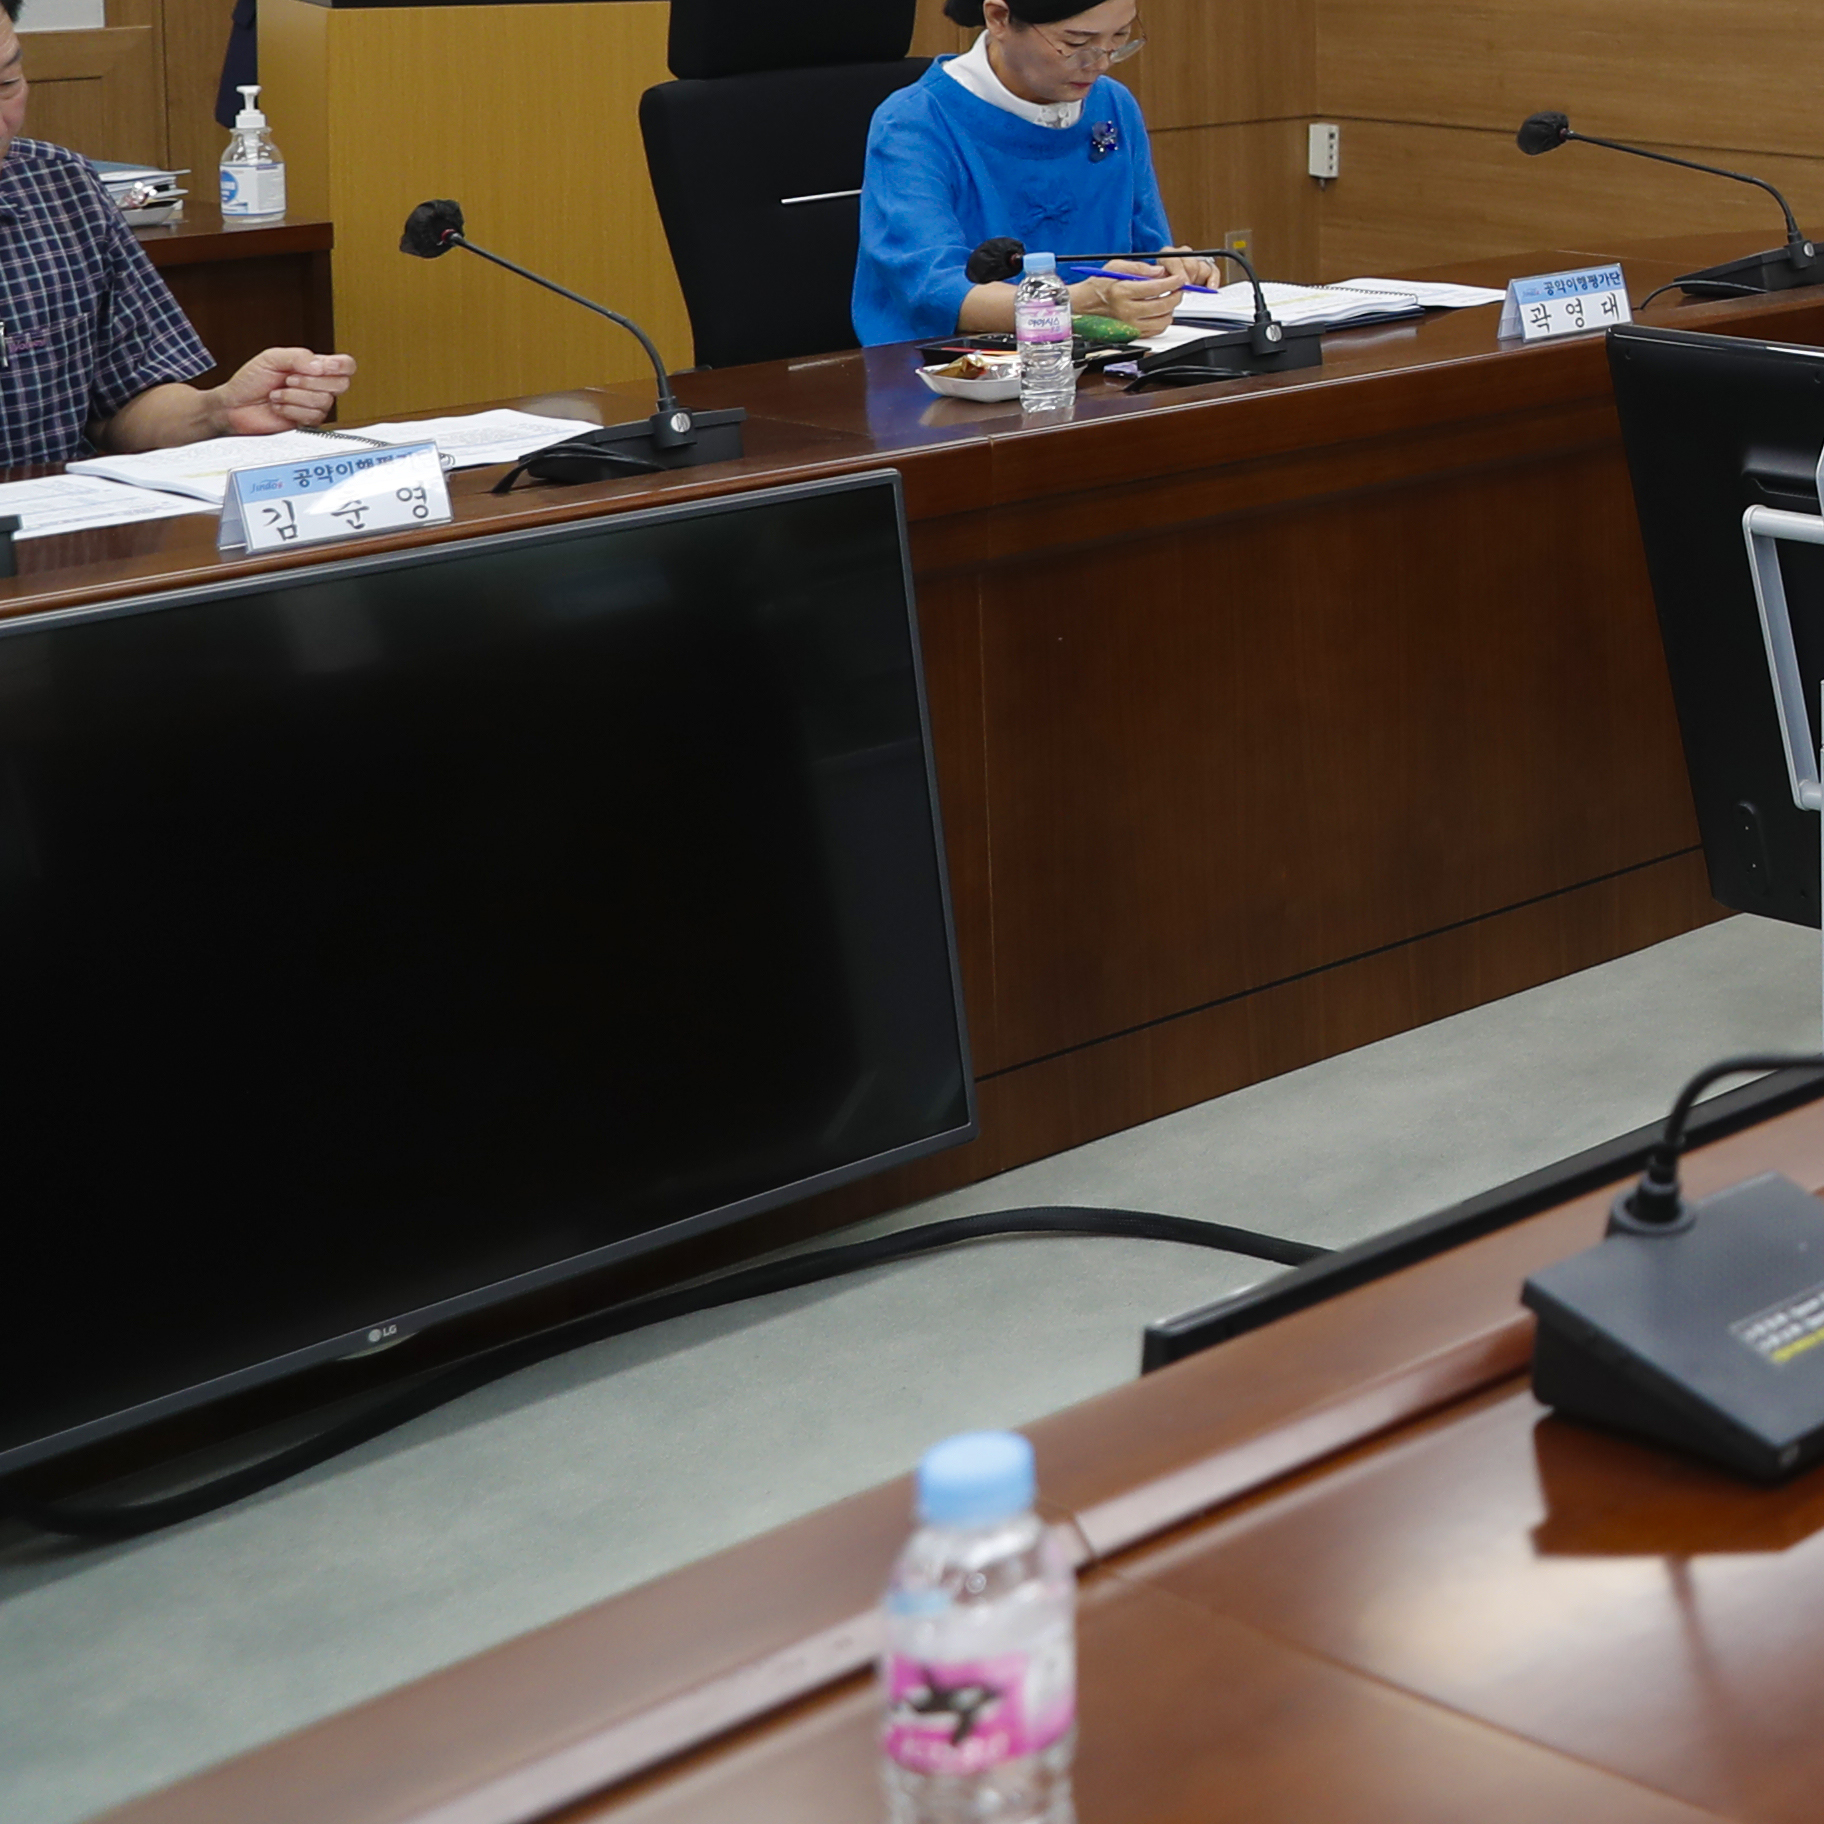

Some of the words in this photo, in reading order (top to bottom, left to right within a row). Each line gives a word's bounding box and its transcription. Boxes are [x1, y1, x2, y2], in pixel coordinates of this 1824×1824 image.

[1543, 270, 1622, 297] 공약이행평가단
[1529, 291, 1621, 334] 곽영대
[383, 1324, 398, 1337] LG
